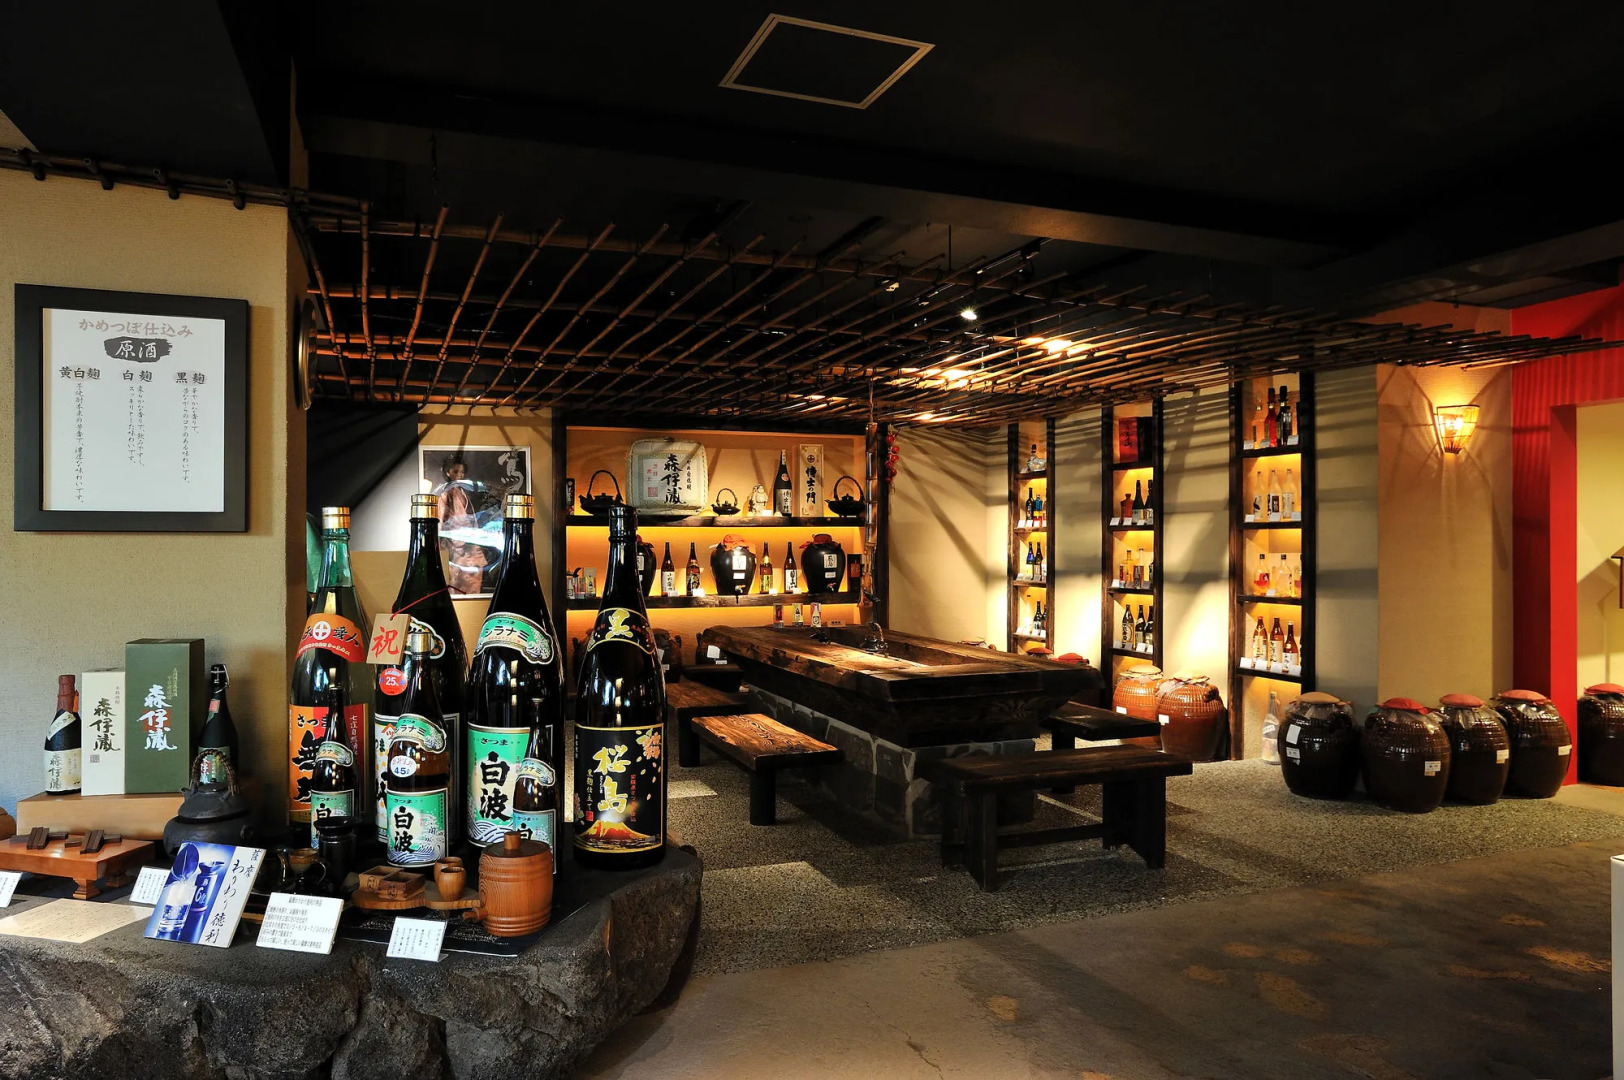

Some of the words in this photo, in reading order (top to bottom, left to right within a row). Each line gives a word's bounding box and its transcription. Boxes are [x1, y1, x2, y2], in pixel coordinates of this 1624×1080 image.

[78, 318, 193, 338] かめつぼ仕込み
[115, 340, 157, 359] 原酒
[58, 365, 101, 380] 黄白麹
[122, 369, 153, 383] 白麹
[175, 371, 206, 385] 黒麹
[660, 453, 686, 504] 森伊蔵
[484, 625, 530, 642] シラナミ
[605, 609, 634, 640] 黒
[371, 626, 400, 659] 祝
[87, 698, 121, 752] 森伊蔵
[136, 684, 178, 751] 森伊蔵
[480, 737, 509, 746] さつま
[479, 751, 513, 822] 白波
[592, 744, 632, 814] 桜島
[393, 806, 418, 853] 白波
